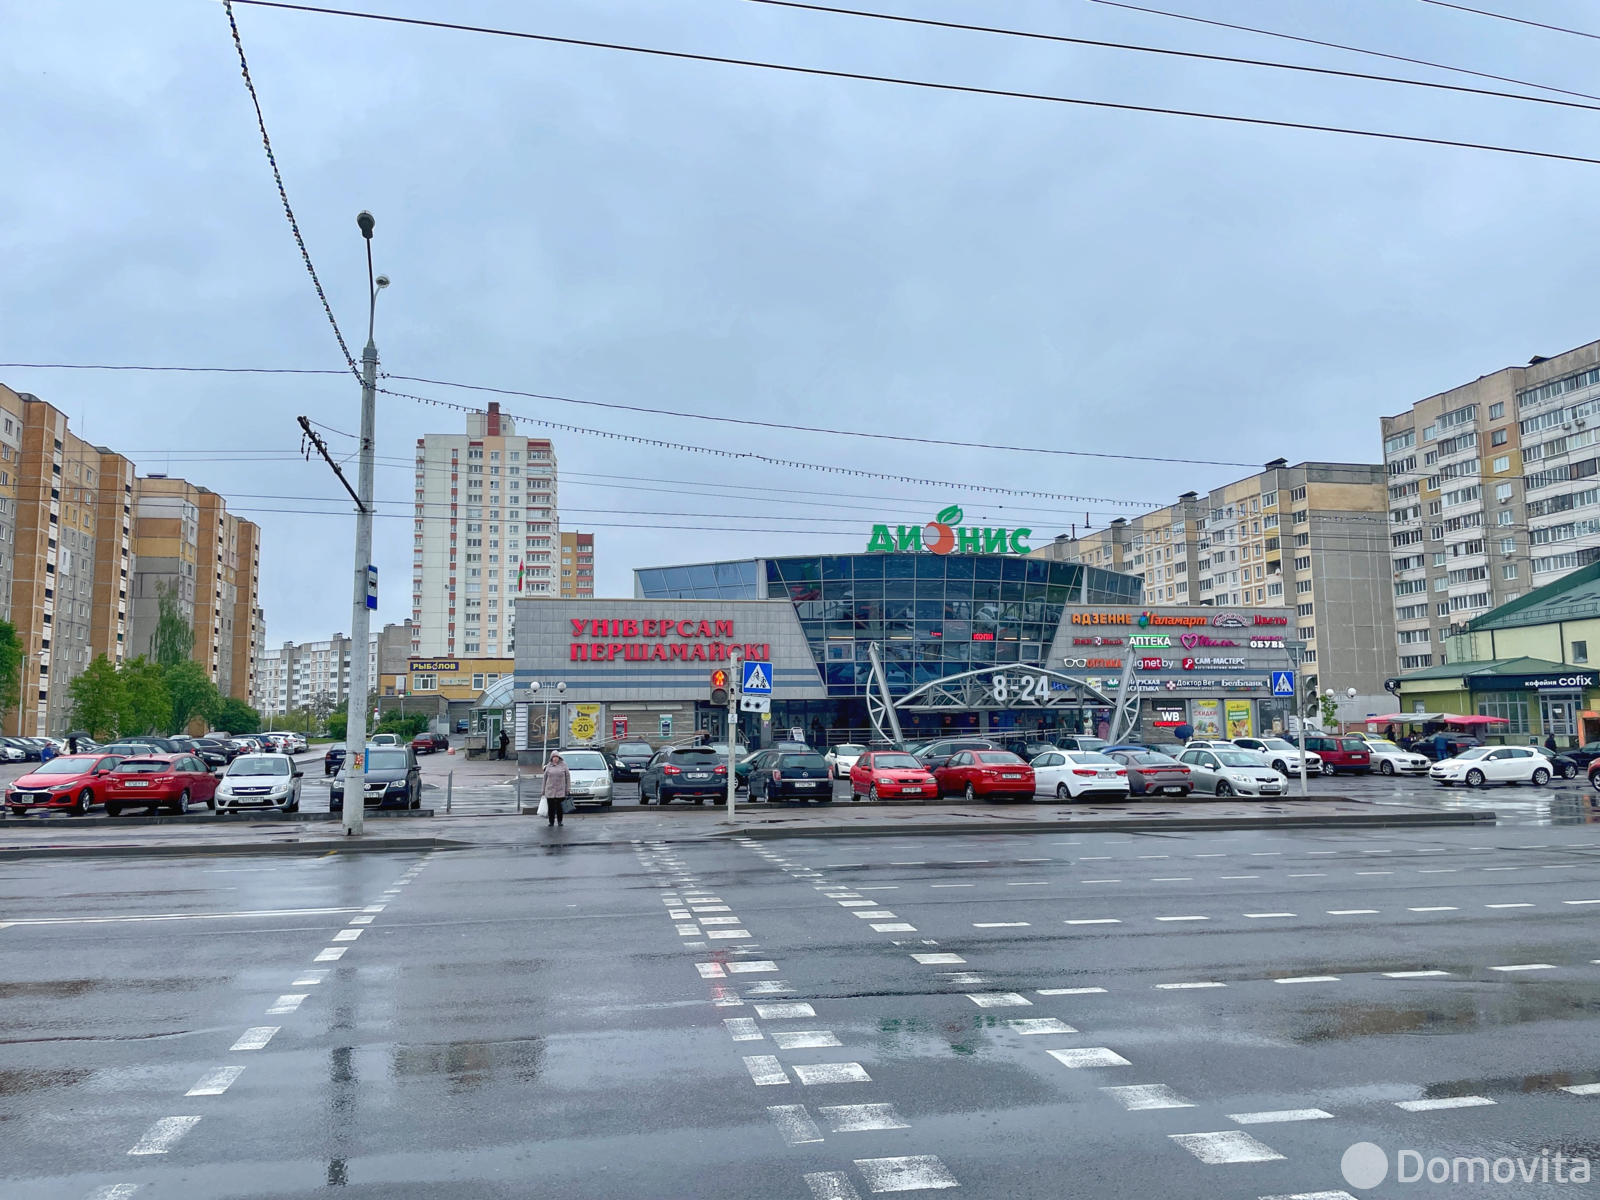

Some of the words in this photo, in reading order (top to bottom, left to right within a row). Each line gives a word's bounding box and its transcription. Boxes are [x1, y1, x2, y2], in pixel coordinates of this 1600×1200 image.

[867, 521, 1033, 555] ДИОНИС
[1071, 613, 1133, 626] АДЗЕННЕ
[1149, 613, 1207, 628] Галамарт
[1253, 615, 1288, 626] Цветы
[570, 618, 734, 637] УНІВЕРСАМ
[1129, 637, 1172, 646] АПТЕКА
[1250, 640, 1285, 649] ОБУВЬ
[570, 641, 771, 661] ПЕРШАМАЙСКІ
[413, 662, 456, 670] РЫБОЛОВ
[1087, 658, 1122, 668] ОПТИКА
[1194, 657, 1245, 665] САМ-МАСТЕРС
[1176, 679, 1202, 687] Доктор
[1558, 675, 1593, 686] cofix
[992, 675, 1050, 701] 8-24
[1161, 711, 1180, 722] WB
